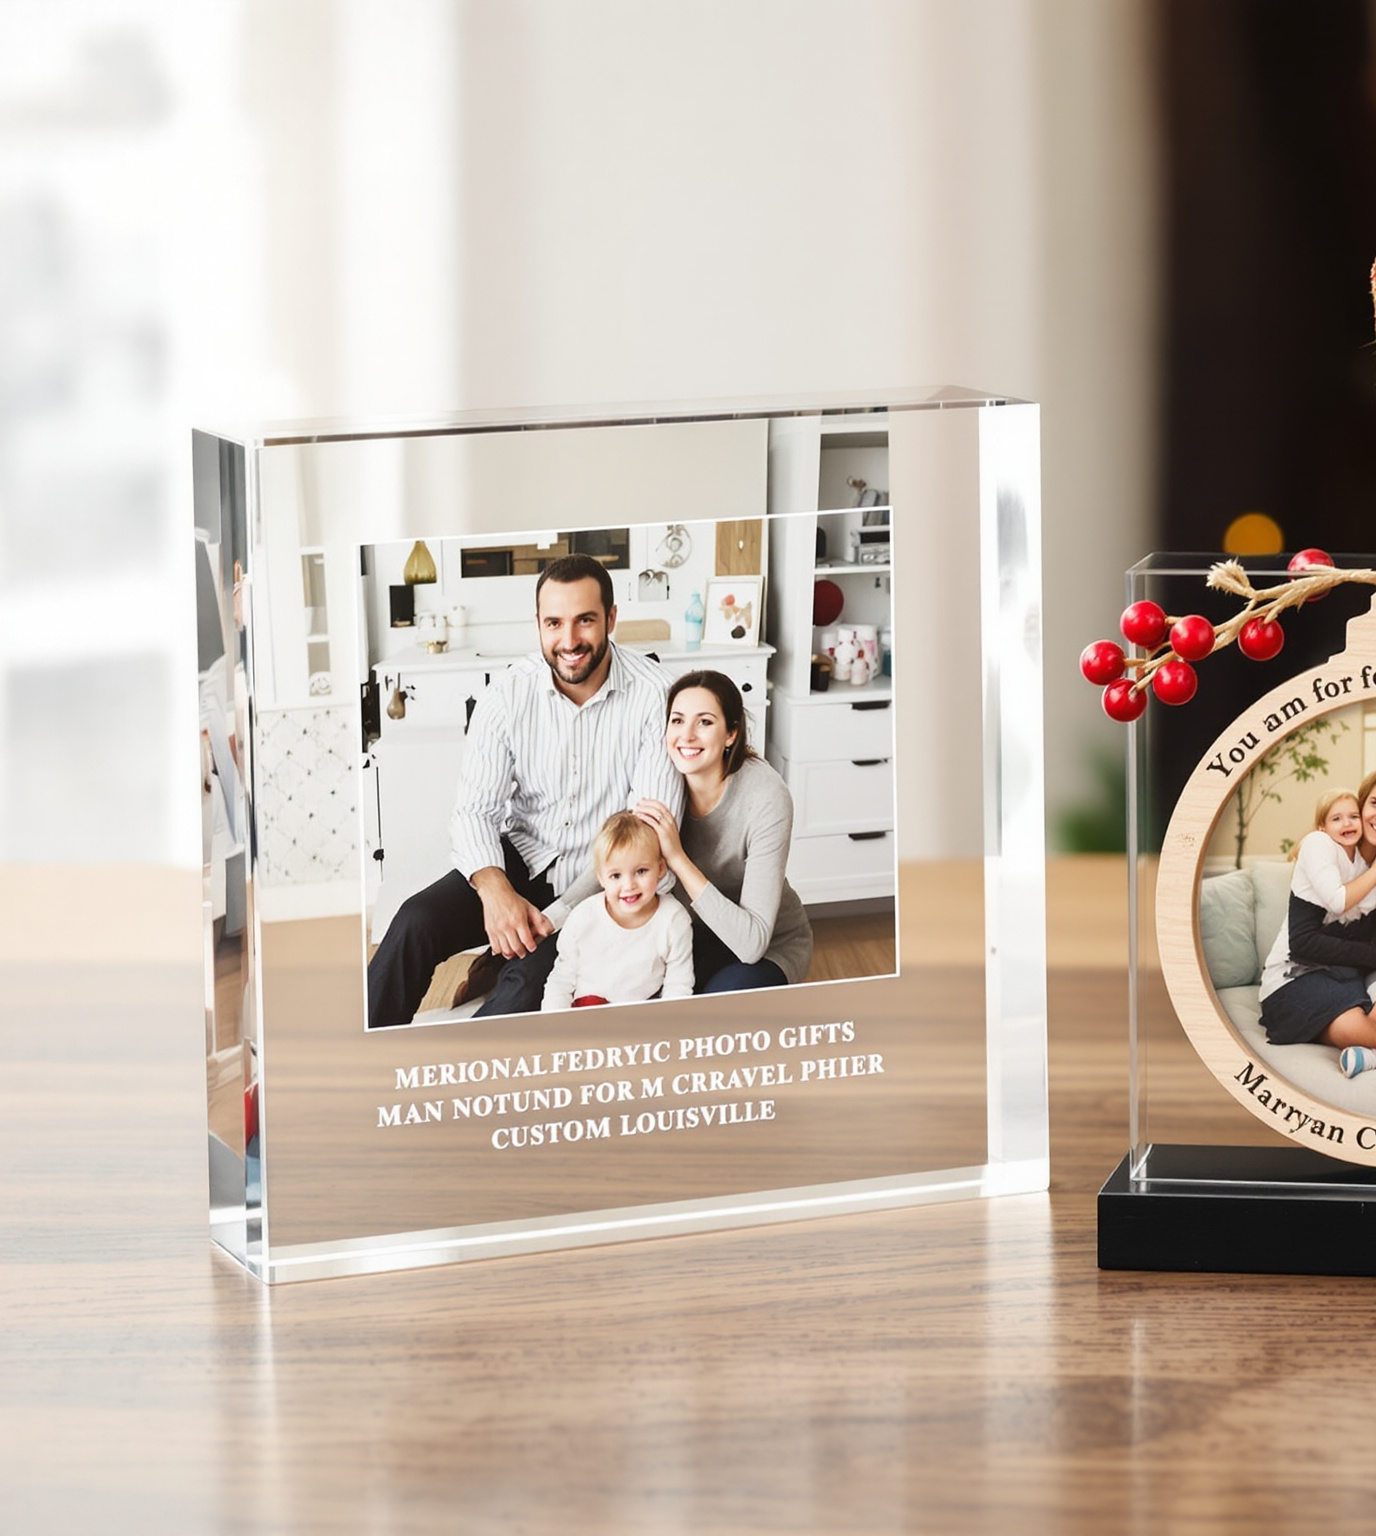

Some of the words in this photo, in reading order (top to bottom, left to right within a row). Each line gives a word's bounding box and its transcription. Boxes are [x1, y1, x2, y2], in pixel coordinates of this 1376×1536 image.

[1205, 731, 1261, 780] You
[1263, 696, 1309, 733] am
[1312, 675, 1354, 703] for
[376, 1099, 444, 1129] MAN
[451, 1086, 573, 1121] NOTUND
[579, 1079, 636, 1106] FOR
[640, 1075, 665, 1100] M
[671, 1062, 794, 1097] CRRAVEL
[800, 1053, 886, 1083] PHIER
[394, 1054, 547, 1091] MERIONAL
[550, 1040, 672, 1075] FEDRYIC
[678, 1029, 772, 1061] PHOTO
[778, 1020, 856, 1050] GIFTS
[490, 1116, 612, 1150] CUSTOM
[619, 1099, 777, 1137] LOUISVILLE
